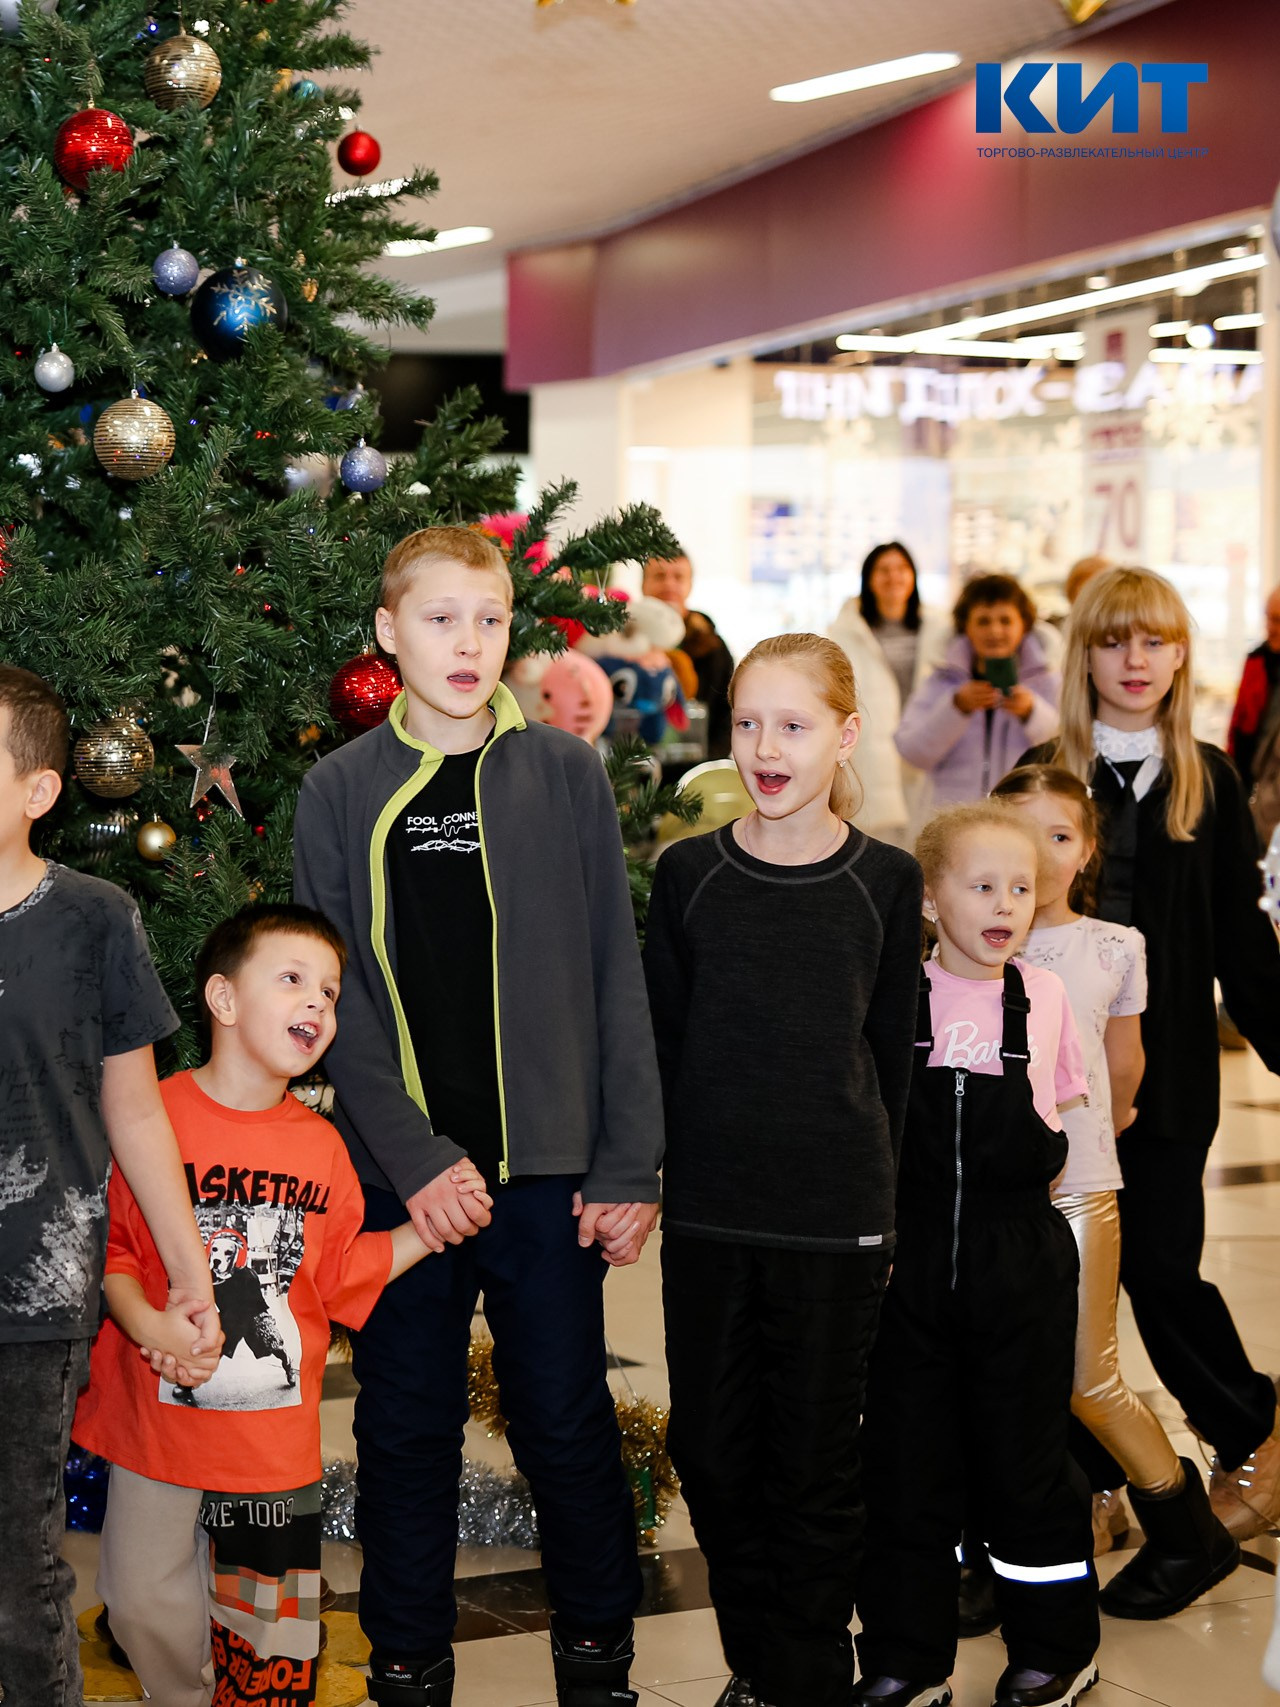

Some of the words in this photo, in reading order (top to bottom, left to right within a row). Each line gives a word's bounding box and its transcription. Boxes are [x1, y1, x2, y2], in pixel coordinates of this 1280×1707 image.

[407, 816, 438, 826] FOOL
[942, 1020, 1041, 1068] Bare
[184, 1162, 331, 1215] SKETBALL
